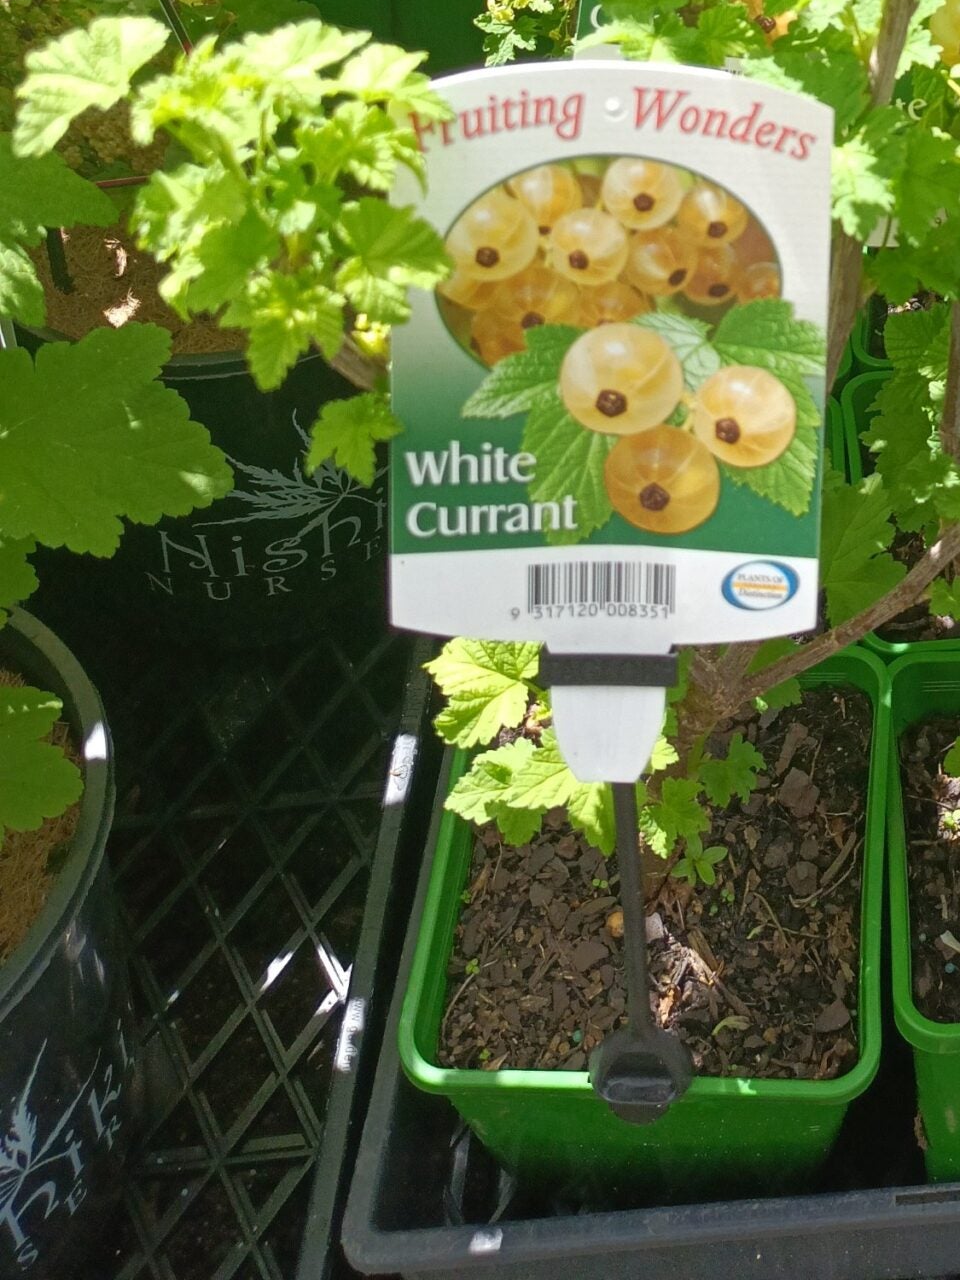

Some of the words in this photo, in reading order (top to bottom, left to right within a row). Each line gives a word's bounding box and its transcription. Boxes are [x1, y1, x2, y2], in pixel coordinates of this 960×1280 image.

[408, 91, 586, 153] Fruiting
[632, 86, 817, 162] Wonders
[405, 440, 537, 486] White
[404, 495, 579, 538] Currant
[510, 606, 521, 620] 9
[533, 602, 599, 620] 317120
[606, 603, 670, 620] 008351
